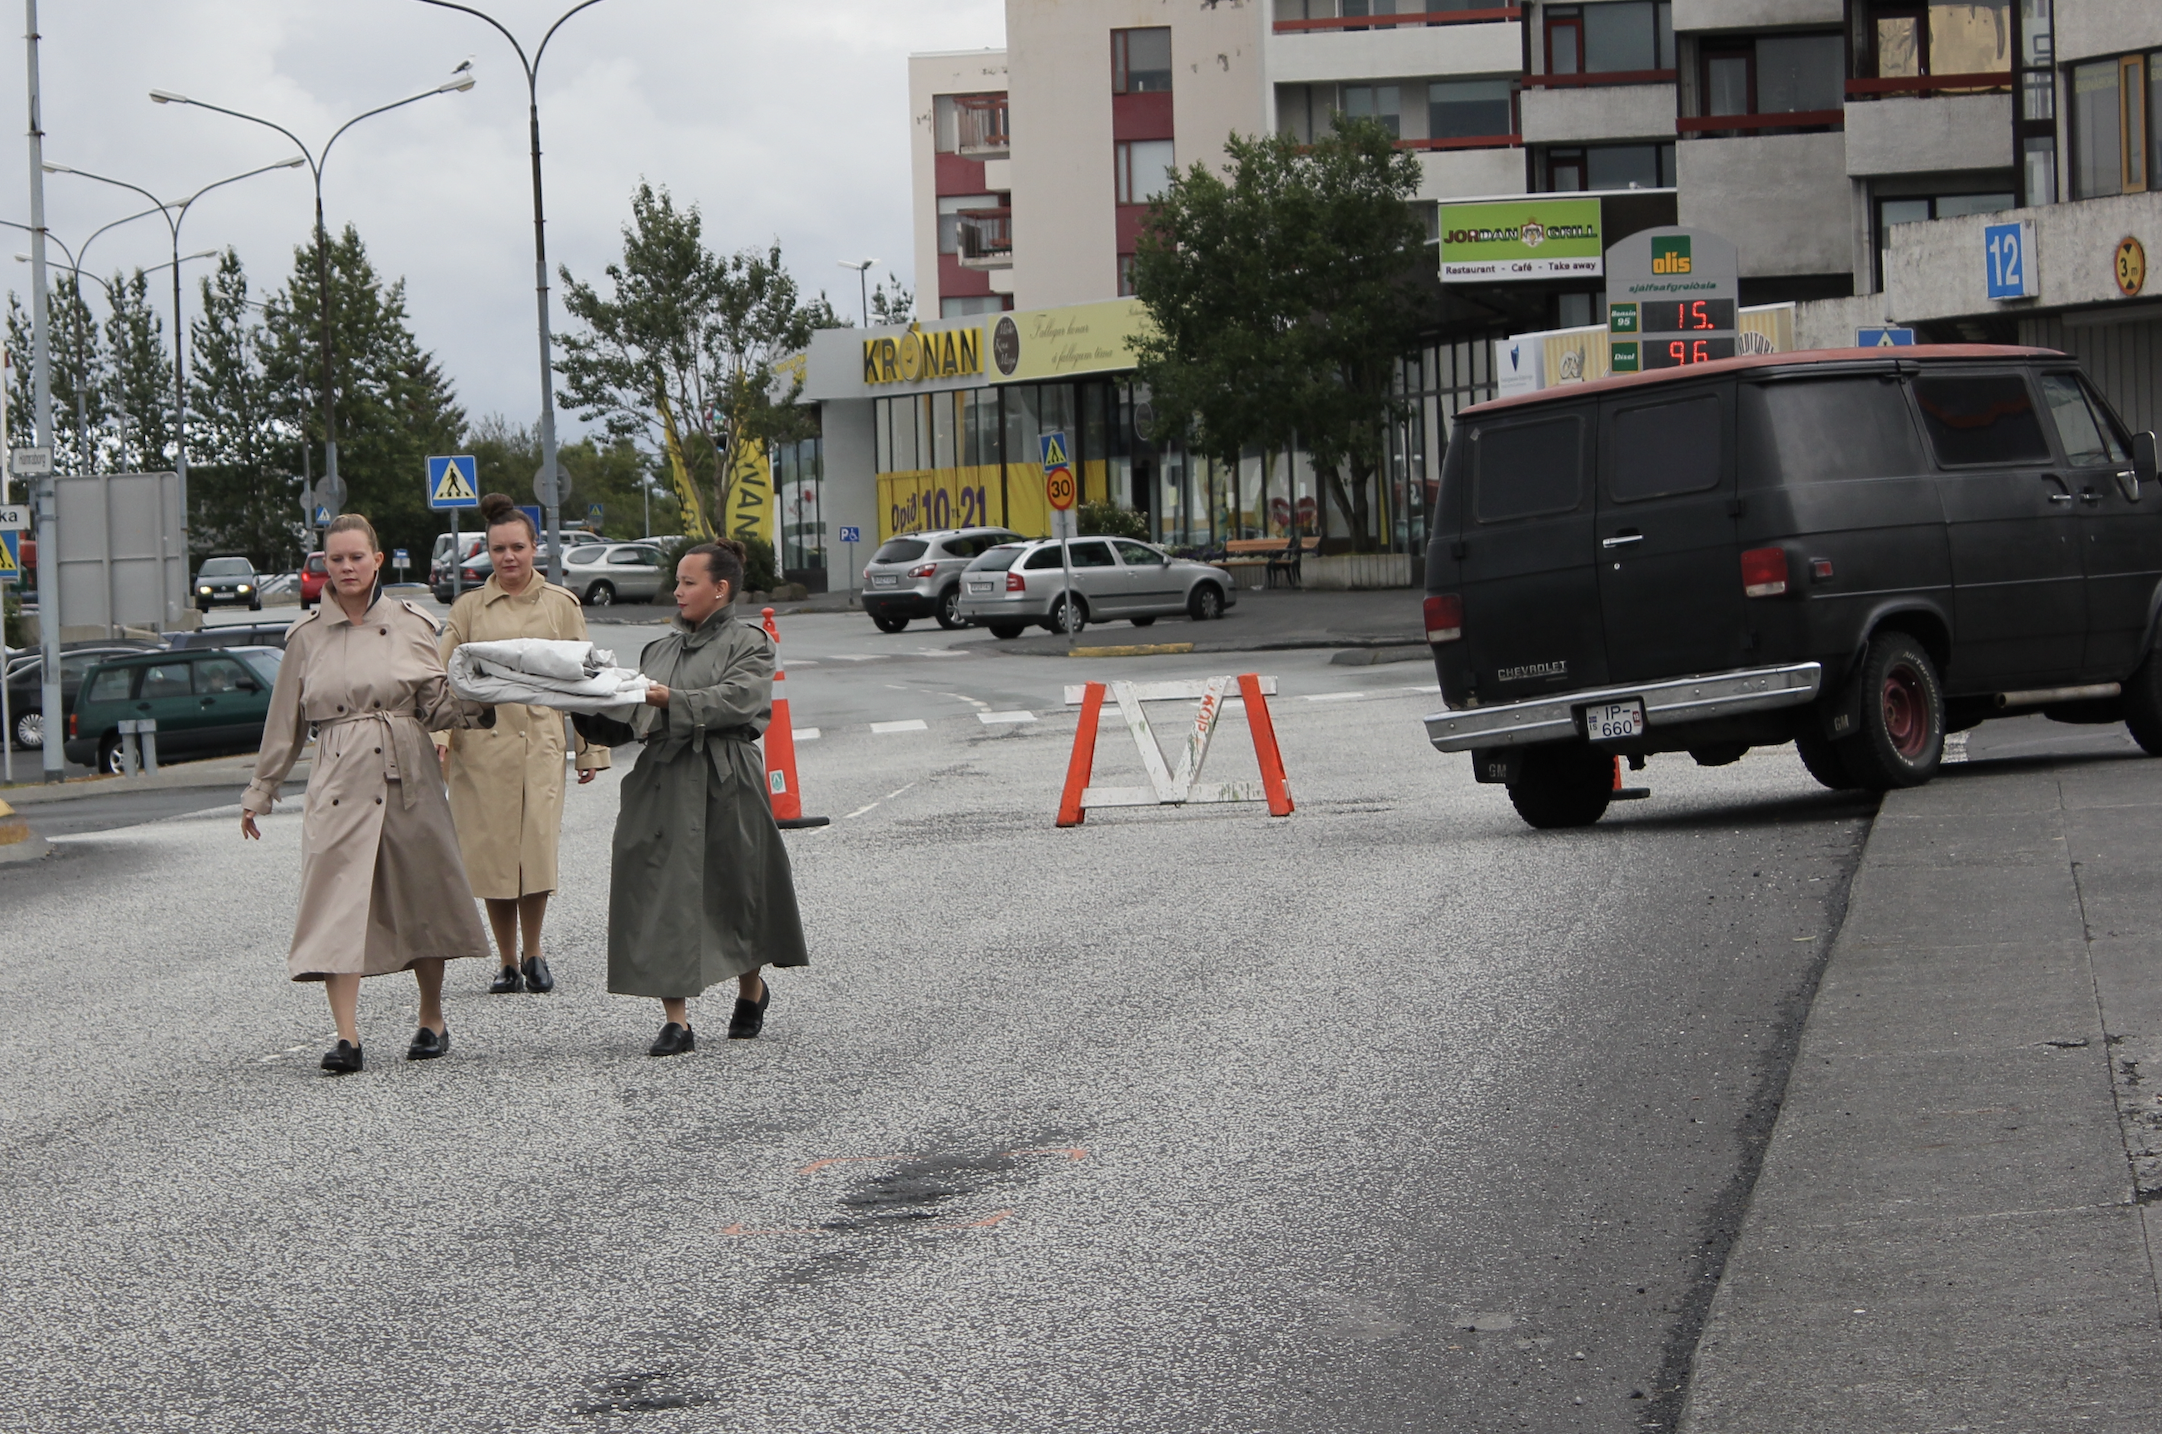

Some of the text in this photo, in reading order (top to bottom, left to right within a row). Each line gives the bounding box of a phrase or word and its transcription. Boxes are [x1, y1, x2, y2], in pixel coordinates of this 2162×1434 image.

[1444, 224, 1598, 244] JORDAN GRILL
[1445, 261, 1596, 275] Restaurant Café Take away
[1989, 233, 2020, 286] 12
[2120, 257, 2138, 277] 3 m
[1617, 317, 1631, 326] 95
[1051, 479, 1071, 498] 30
[922, 488, 950, 530] 10
[961, 485, 986, 528] 21
[841, 528, 849, 541] P
[1497, 660, 1567, 678] CHEVROLET
[1602, 719, 1633, 737] 660
[1834, 714, 1849, 731] GM
[1488, 763, 1507, 778] GM
